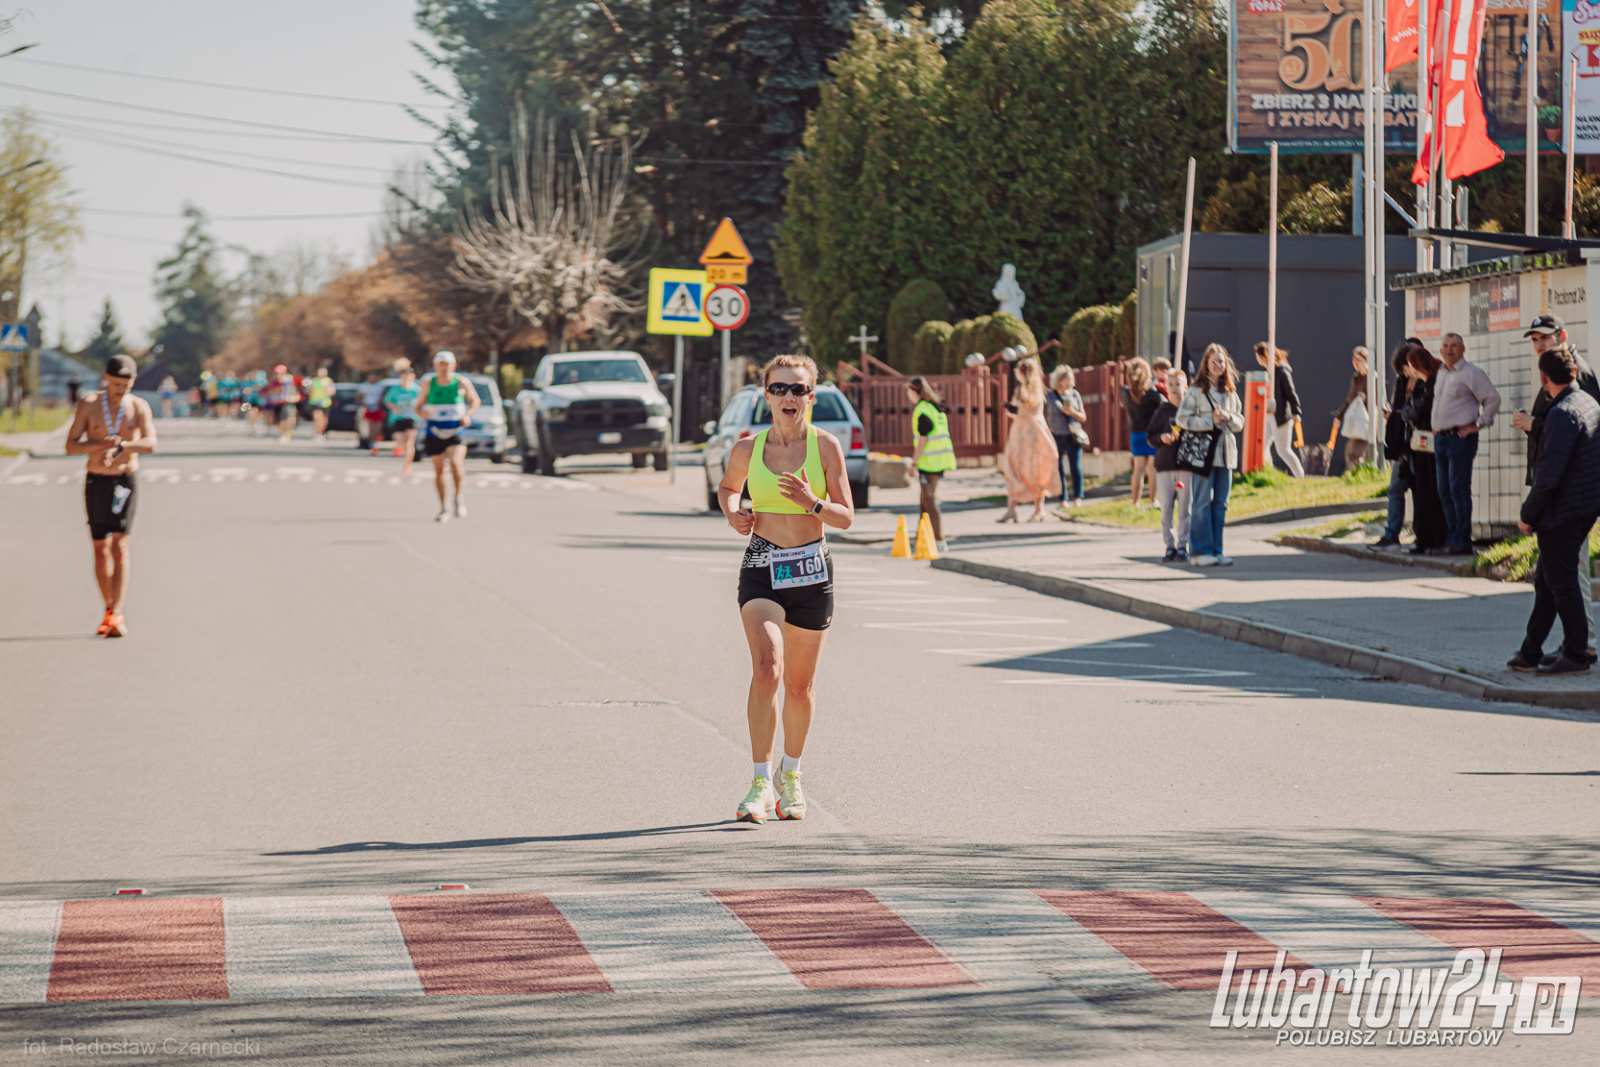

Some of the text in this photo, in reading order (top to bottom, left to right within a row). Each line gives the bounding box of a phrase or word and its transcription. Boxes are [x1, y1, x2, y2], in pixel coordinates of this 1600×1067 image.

[1251, 93, 1418, 111] ZBIERZ 3 NAEJKI
[1267, 111, 1419, 129] I ZYSKAJ RBAT
[711, 295, 743, 317] 30
[796, 556, 823, 576] 160
